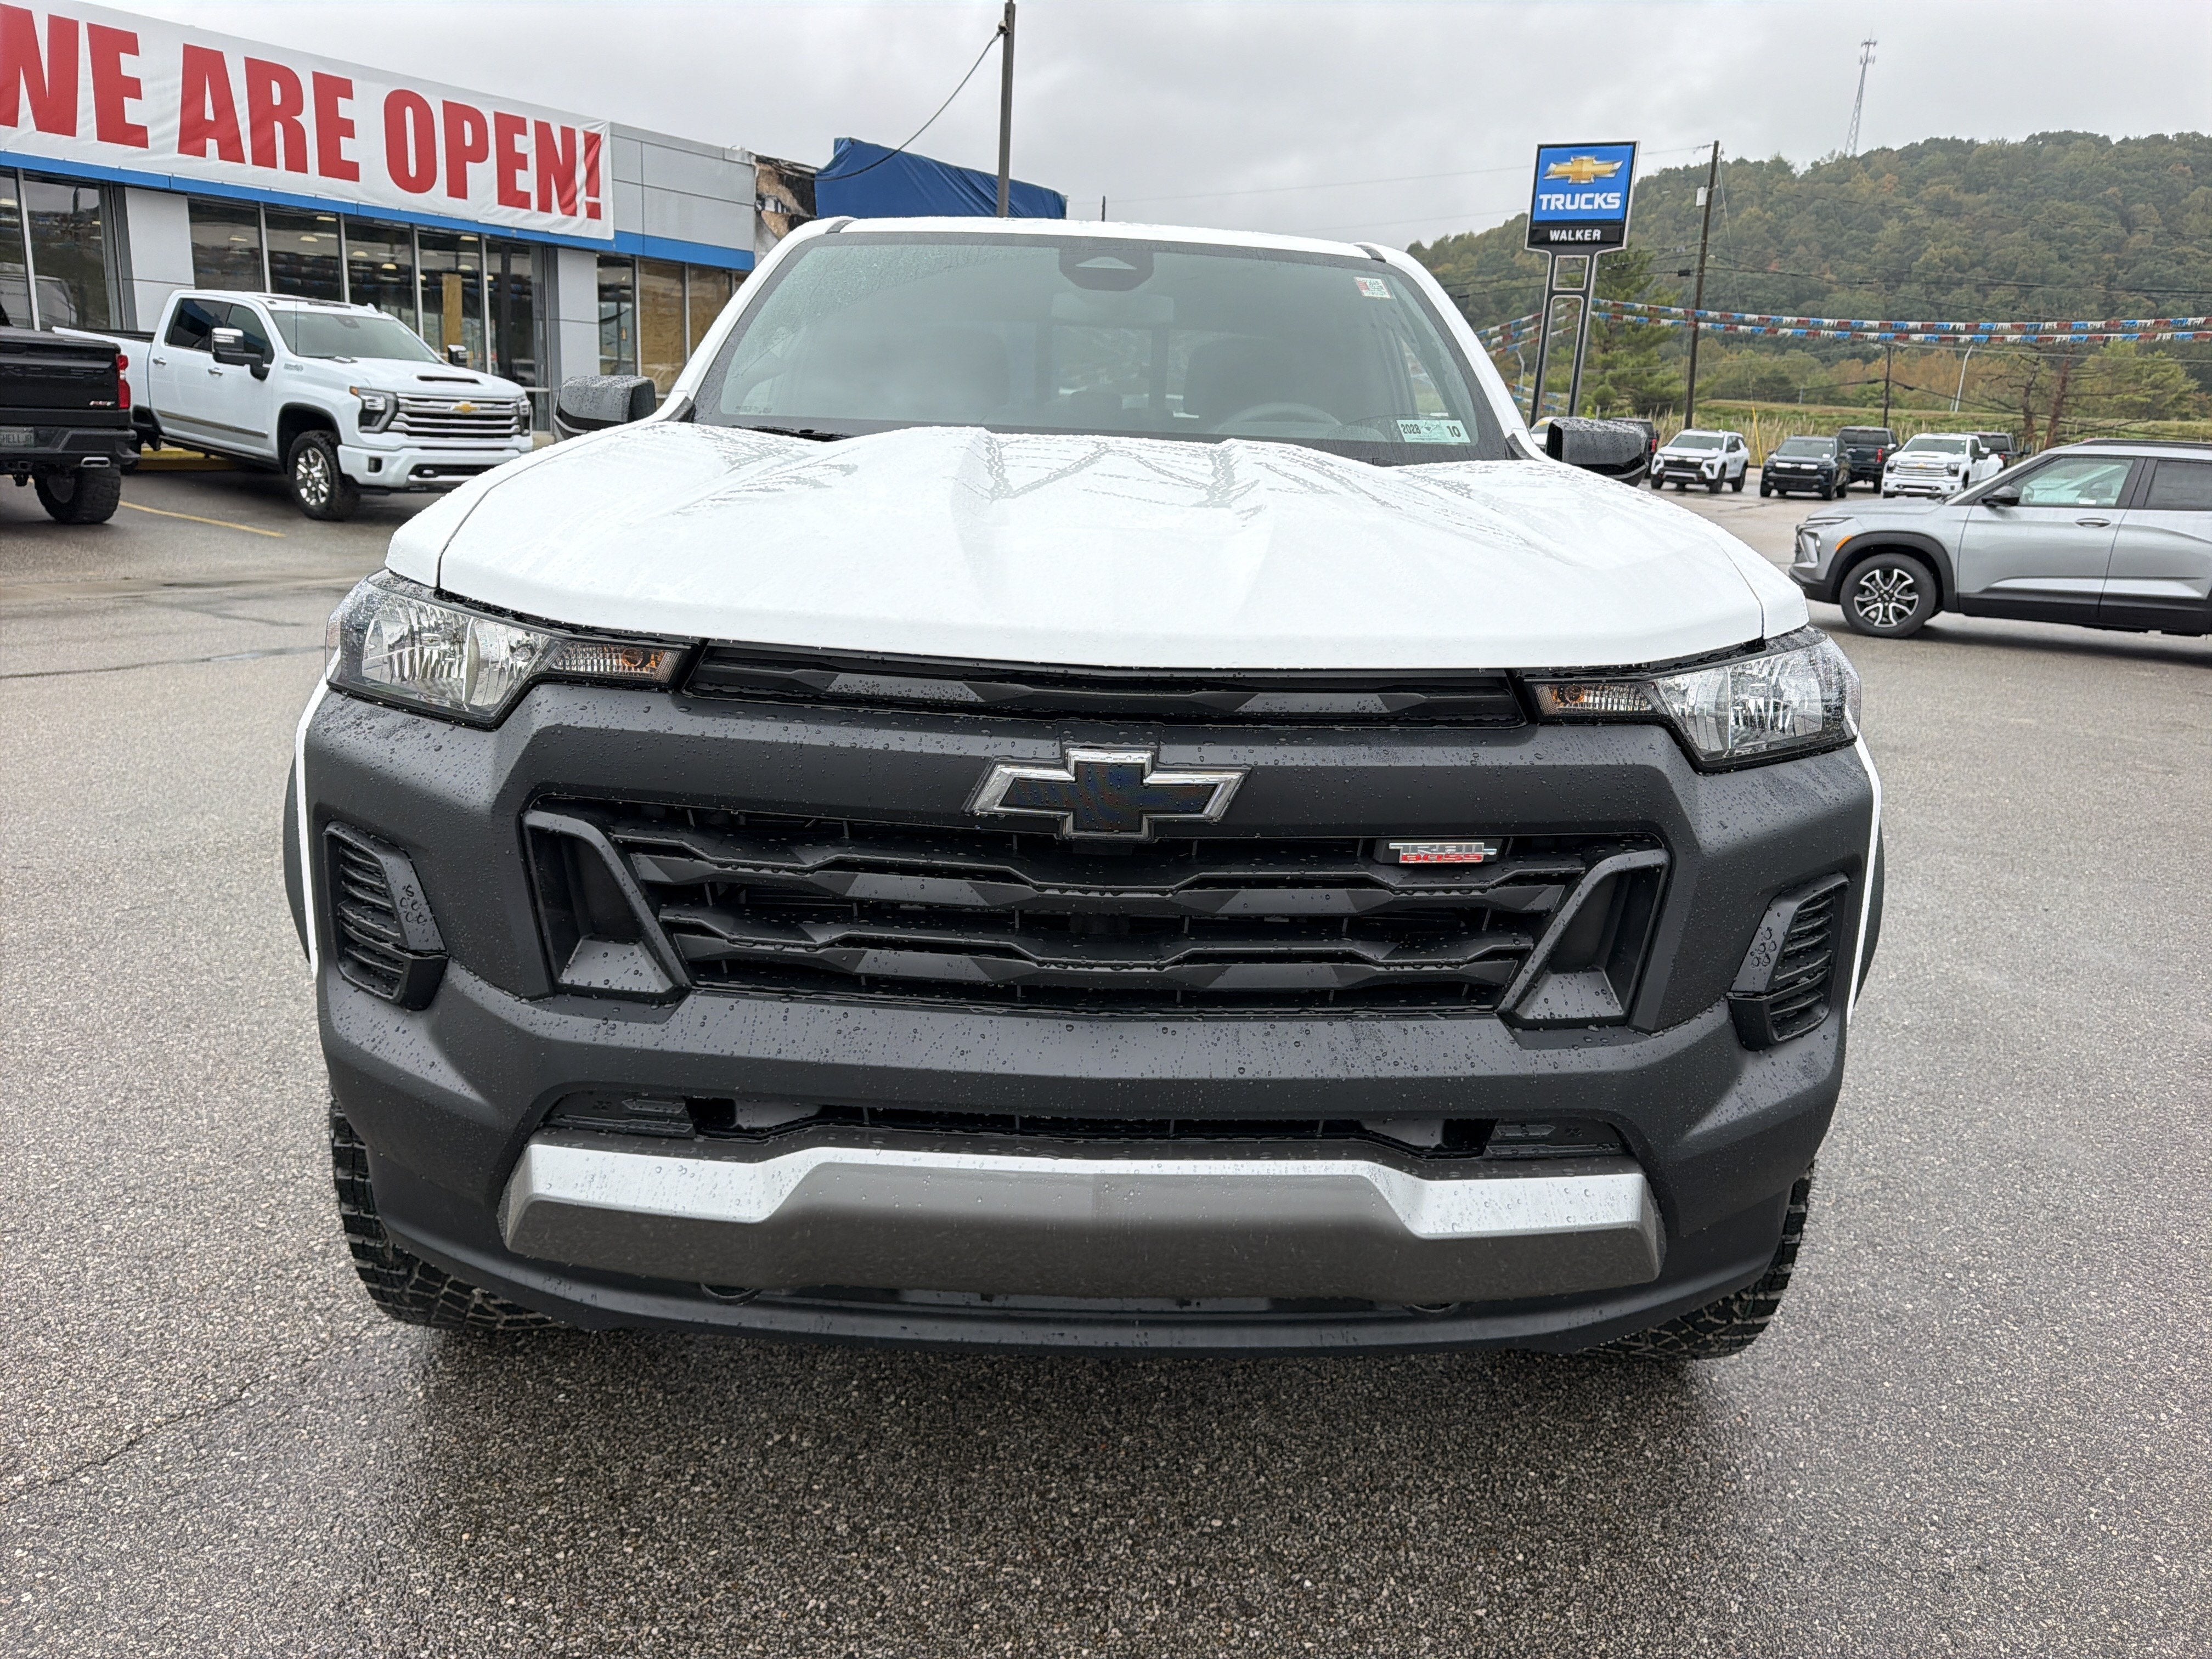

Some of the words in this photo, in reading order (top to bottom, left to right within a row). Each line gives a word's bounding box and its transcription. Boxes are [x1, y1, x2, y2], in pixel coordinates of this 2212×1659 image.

[177, 43, 360, 183] ARE
[383, 88, 601, 221] OPEN!
[1539, 193, 1621, 210] TRUCKS
[1549, 229, 1601, 241] WALKER
[1446, 425, 1462, 437] 10
[1400, 854, 1483, 863] BOSS
